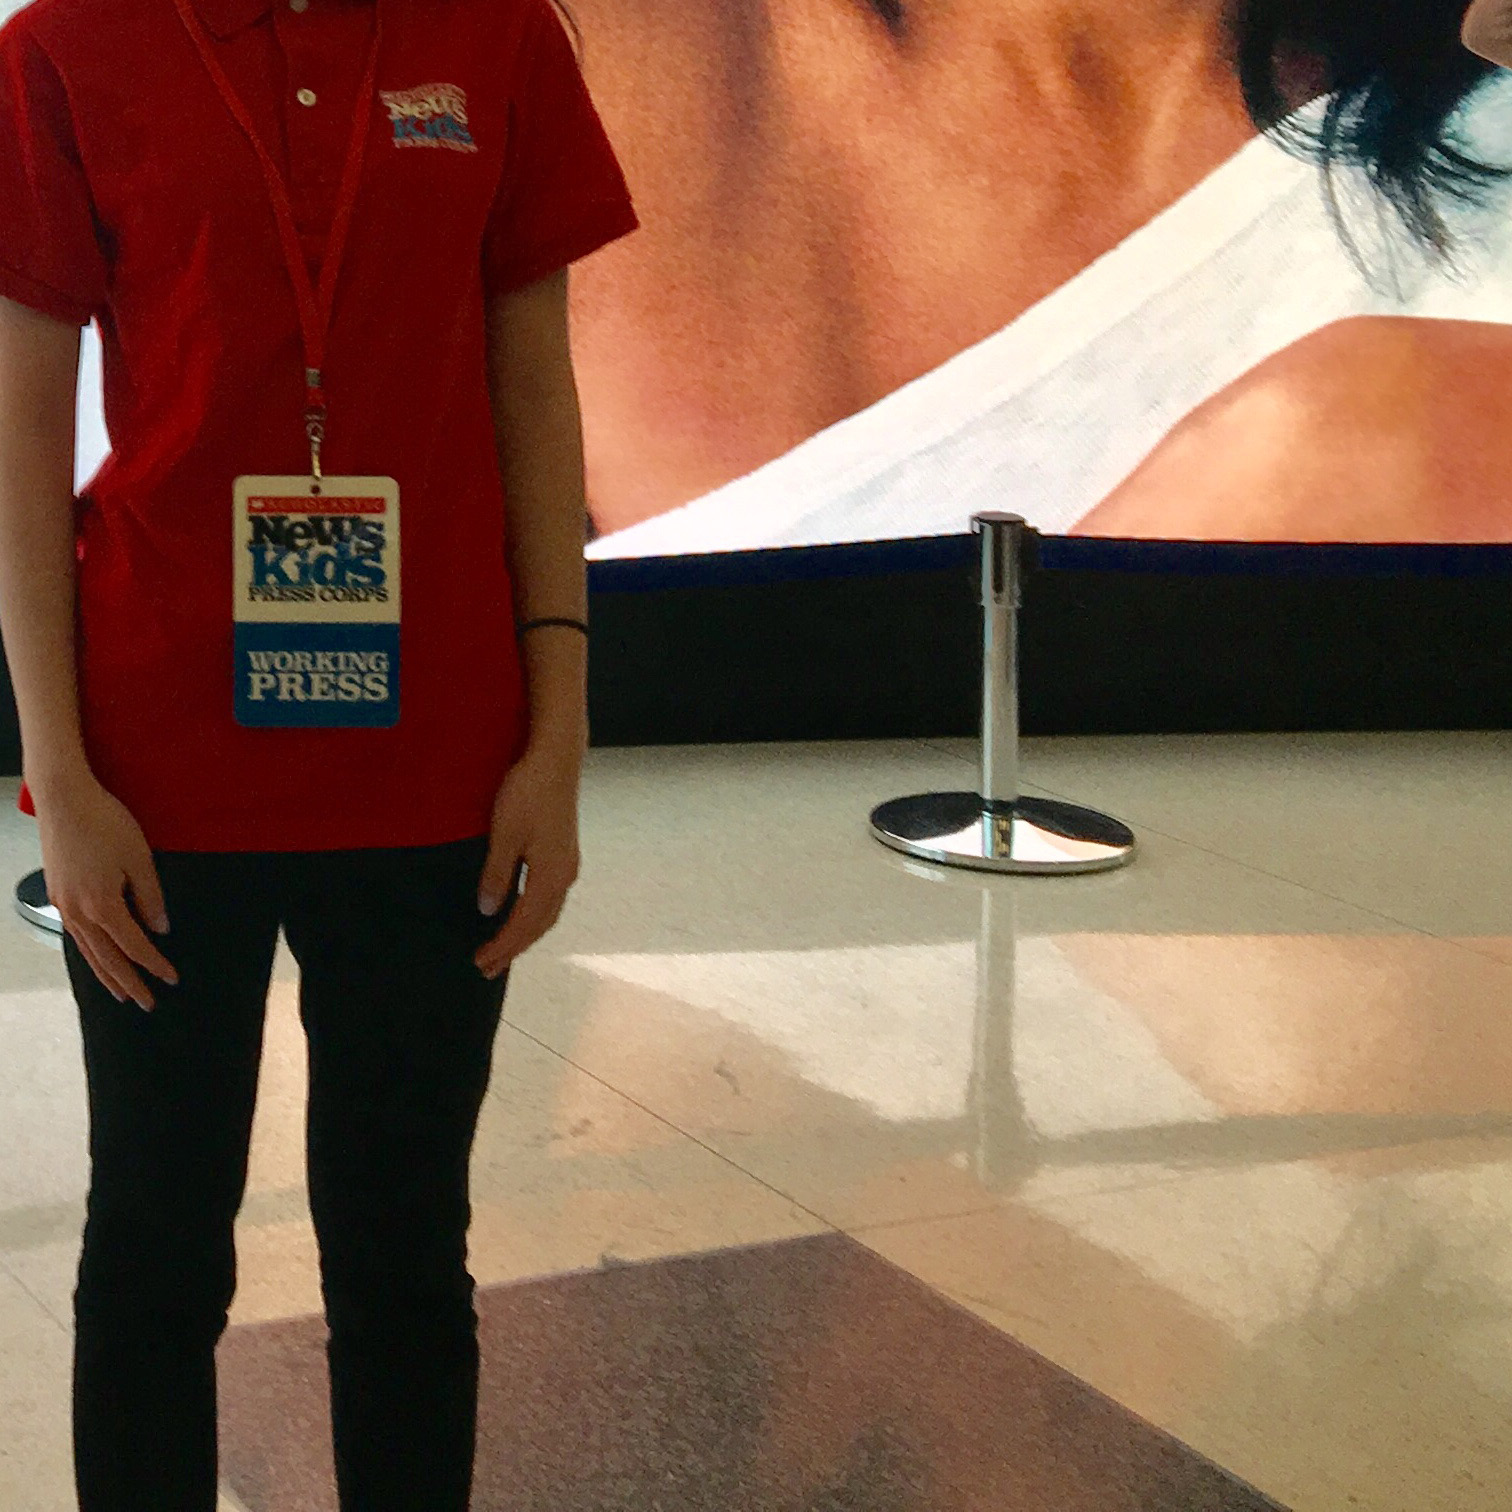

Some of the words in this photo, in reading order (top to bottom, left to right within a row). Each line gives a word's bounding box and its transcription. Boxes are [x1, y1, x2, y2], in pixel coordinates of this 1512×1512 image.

[247, 514, 386, 554] News
[247, 542, 387, 587] Kids
[247, 585, 316, 603] PRESS
[318, 585, 389, 603] CORPS
[246, 650, 390, 673] WORKING
[246, 672, 390, 702] PRESS
